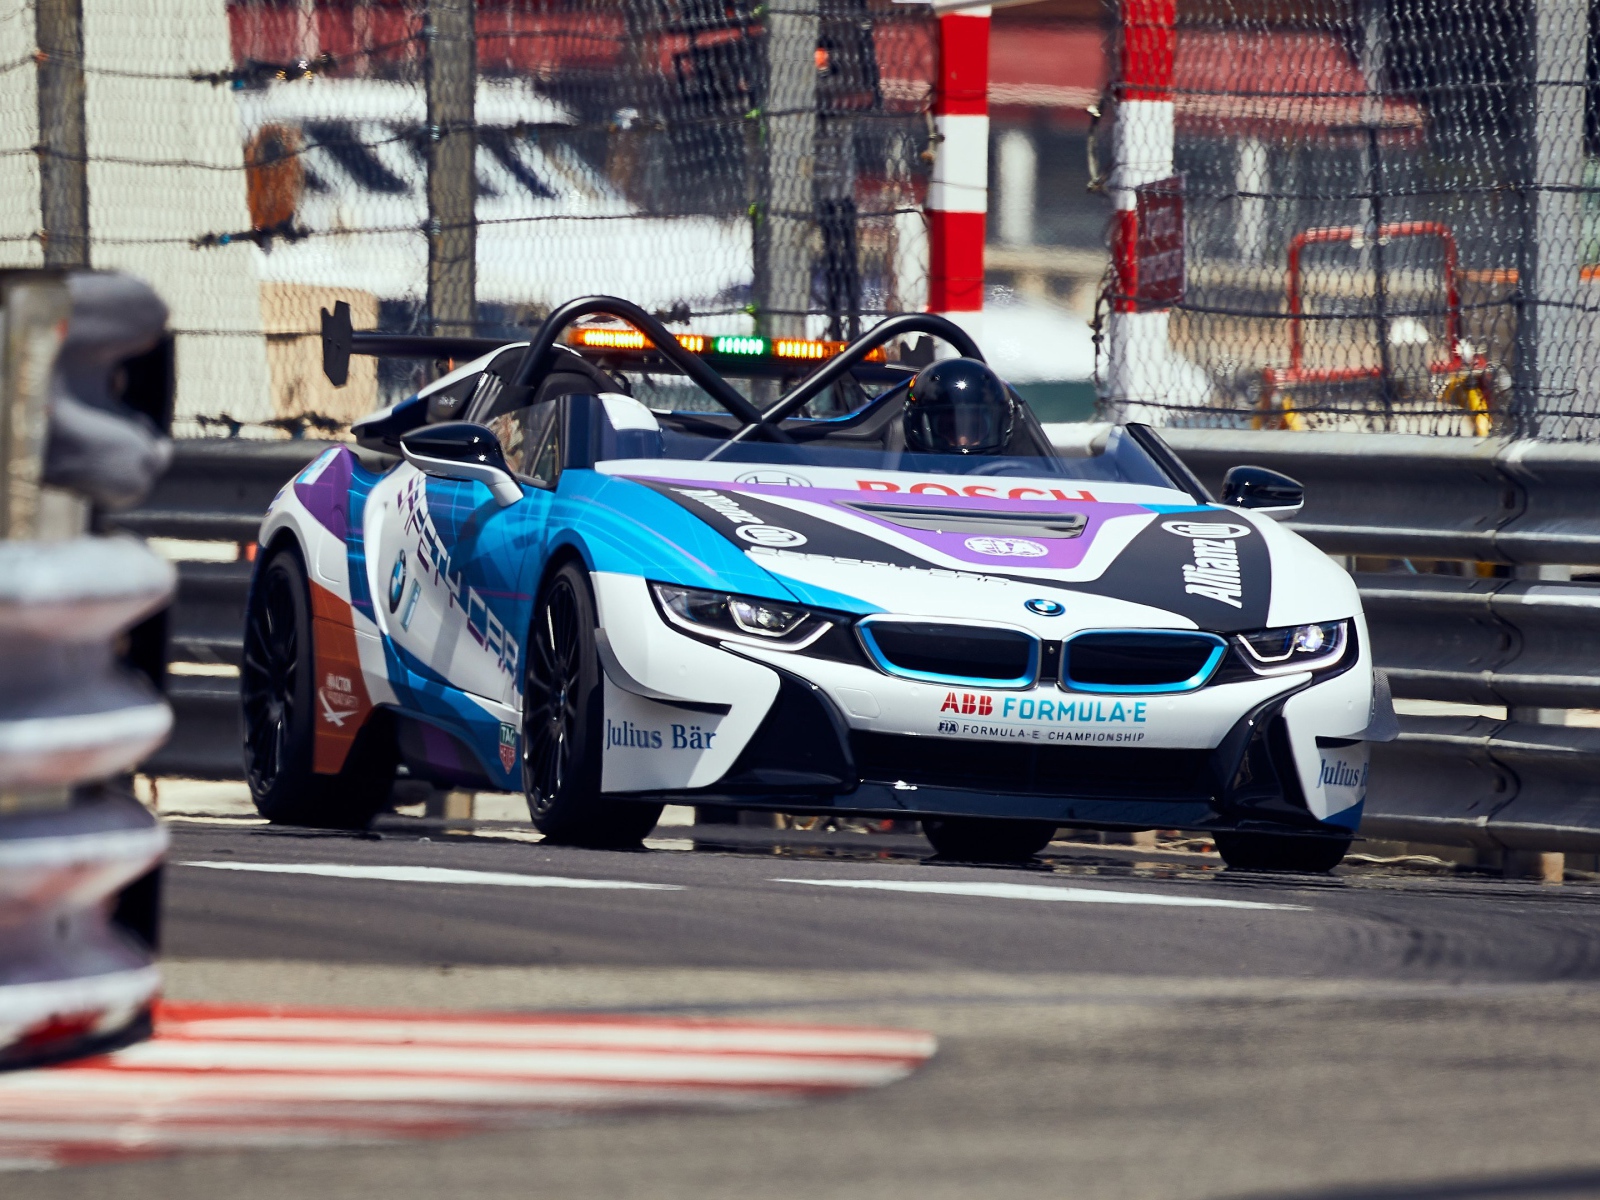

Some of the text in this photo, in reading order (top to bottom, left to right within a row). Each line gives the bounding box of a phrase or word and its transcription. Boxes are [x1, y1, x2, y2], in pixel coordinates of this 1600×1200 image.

[856, 480, 1098, 503] BOSCH
[1181, 538, 1243, 609] Allianz
[940, 692, 994, 716] ABB
[501, 725, 515, 746] TAG
[606, 718, 717, 750] Julius Bär
[937, 719, 960, 735] FIA
[1048, 731, 1145, 743] CHAMPIONSHIP
[1316, 758, 1360, 789] Julius
